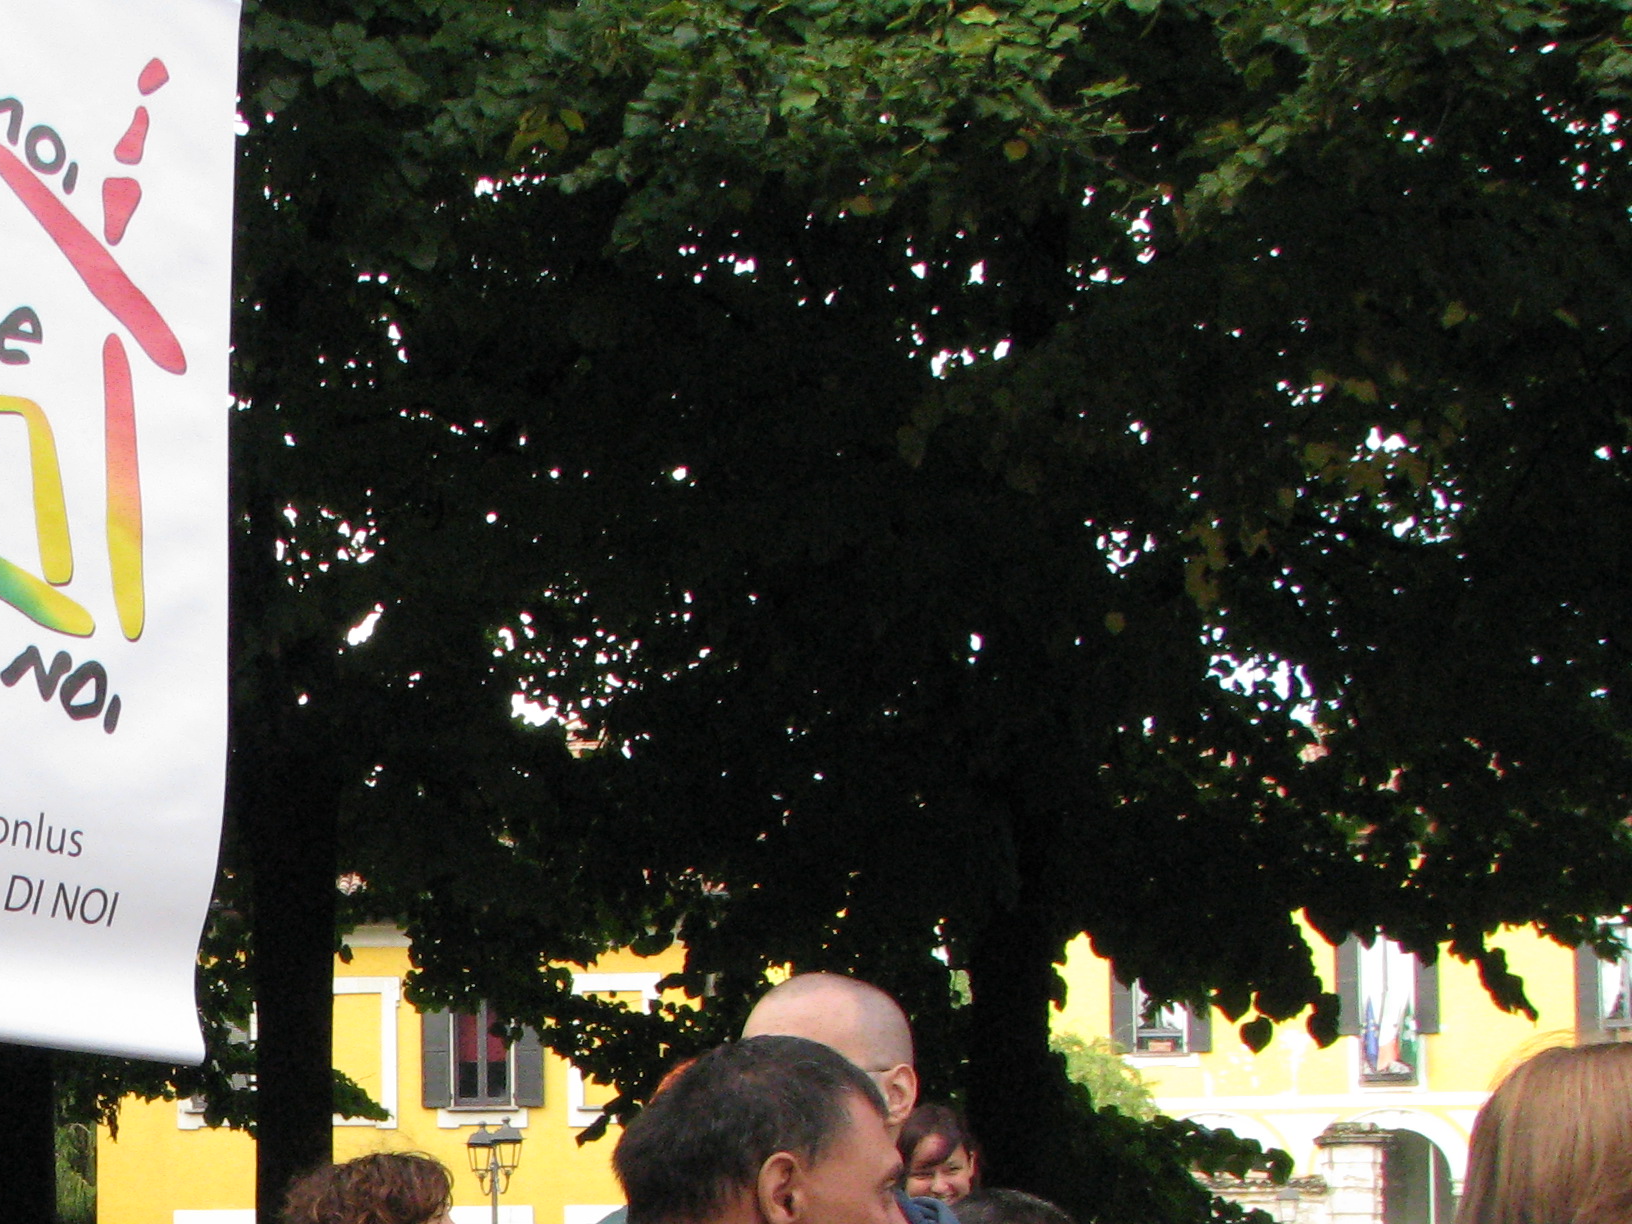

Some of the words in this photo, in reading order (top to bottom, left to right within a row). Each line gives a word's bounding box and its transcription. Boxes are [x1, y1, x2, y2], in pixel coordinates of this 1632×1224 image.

[0, 645, 122, 733] NOI
[3, 874, 45, 915] DI
[50, 882, 120, 927] NOI
